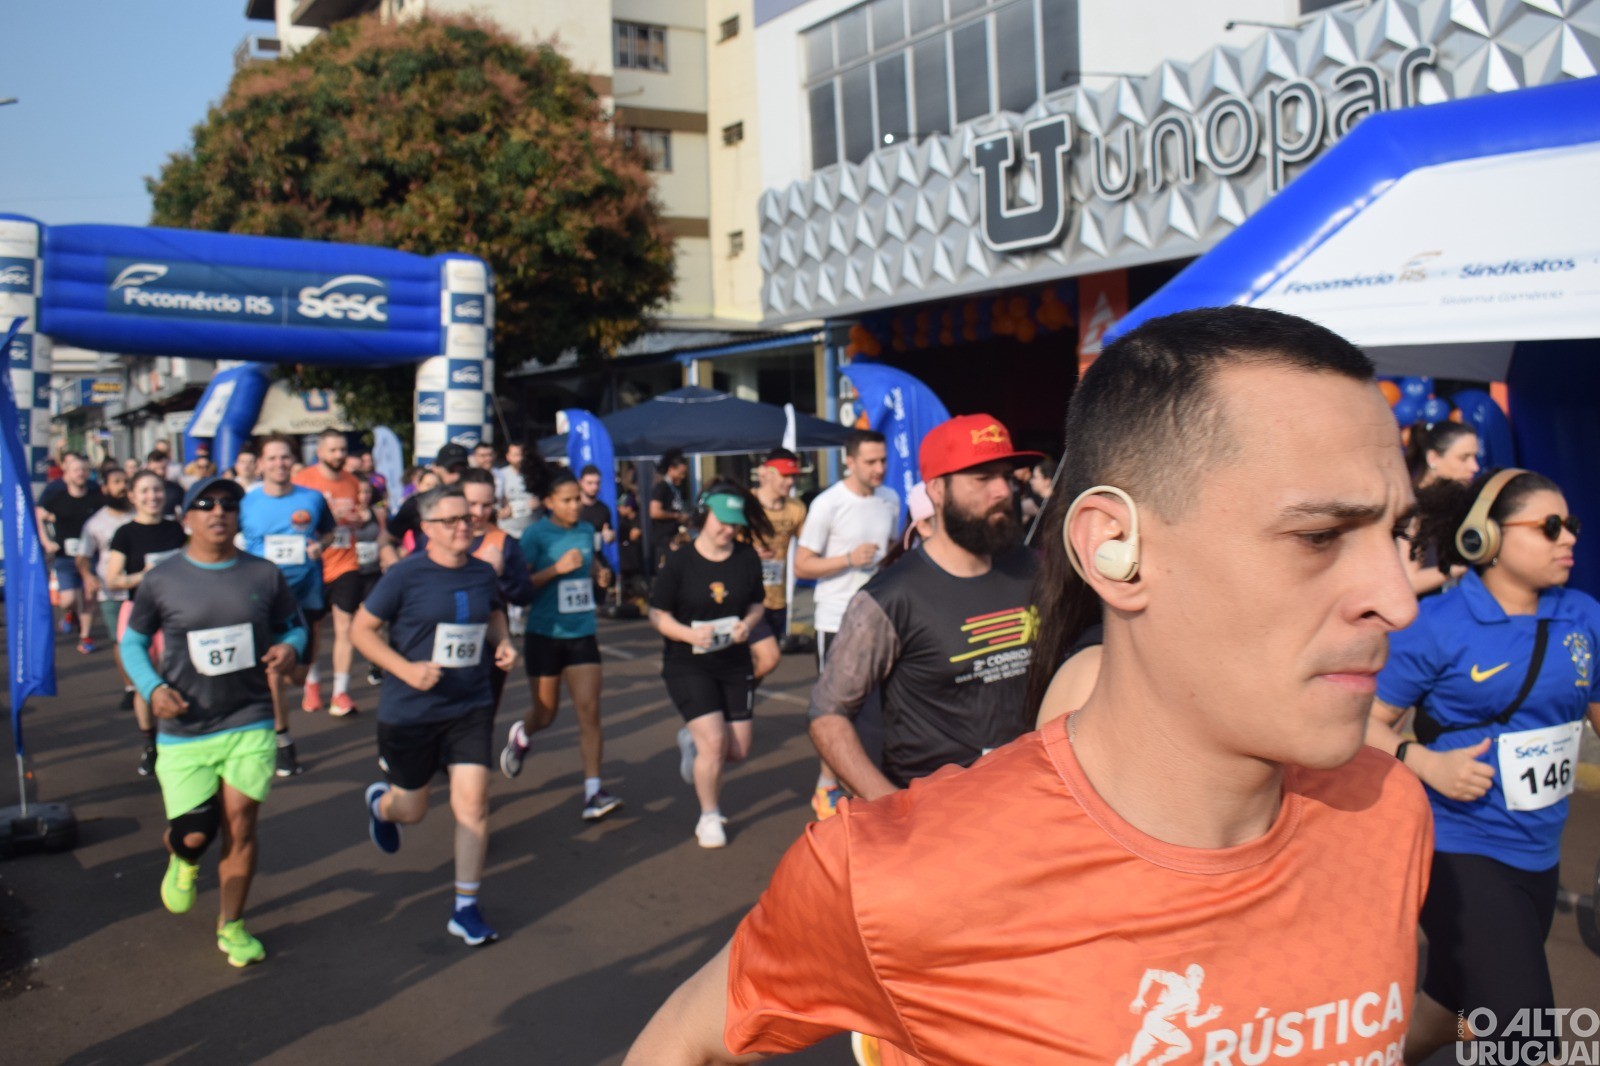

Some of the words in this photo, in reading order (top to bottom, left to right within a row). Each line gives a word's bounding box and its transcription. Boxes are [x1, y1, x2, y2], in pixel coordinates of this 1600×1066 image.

[1091, 44, 1437, 201] unopar
[1459, 257, 1577, 280] Sindicatos
[124, 287, 243, 312] Fecomércio
[244, 295, 275, 315] RS
[297, 284, 388, 322] Sesc
[209, 646, 237, 667] 87
[445, 643, 477, 659] 169
[1520, 758, 1571, 796] 146
[1203, 981, 1404, 1066] RÚSTICA
